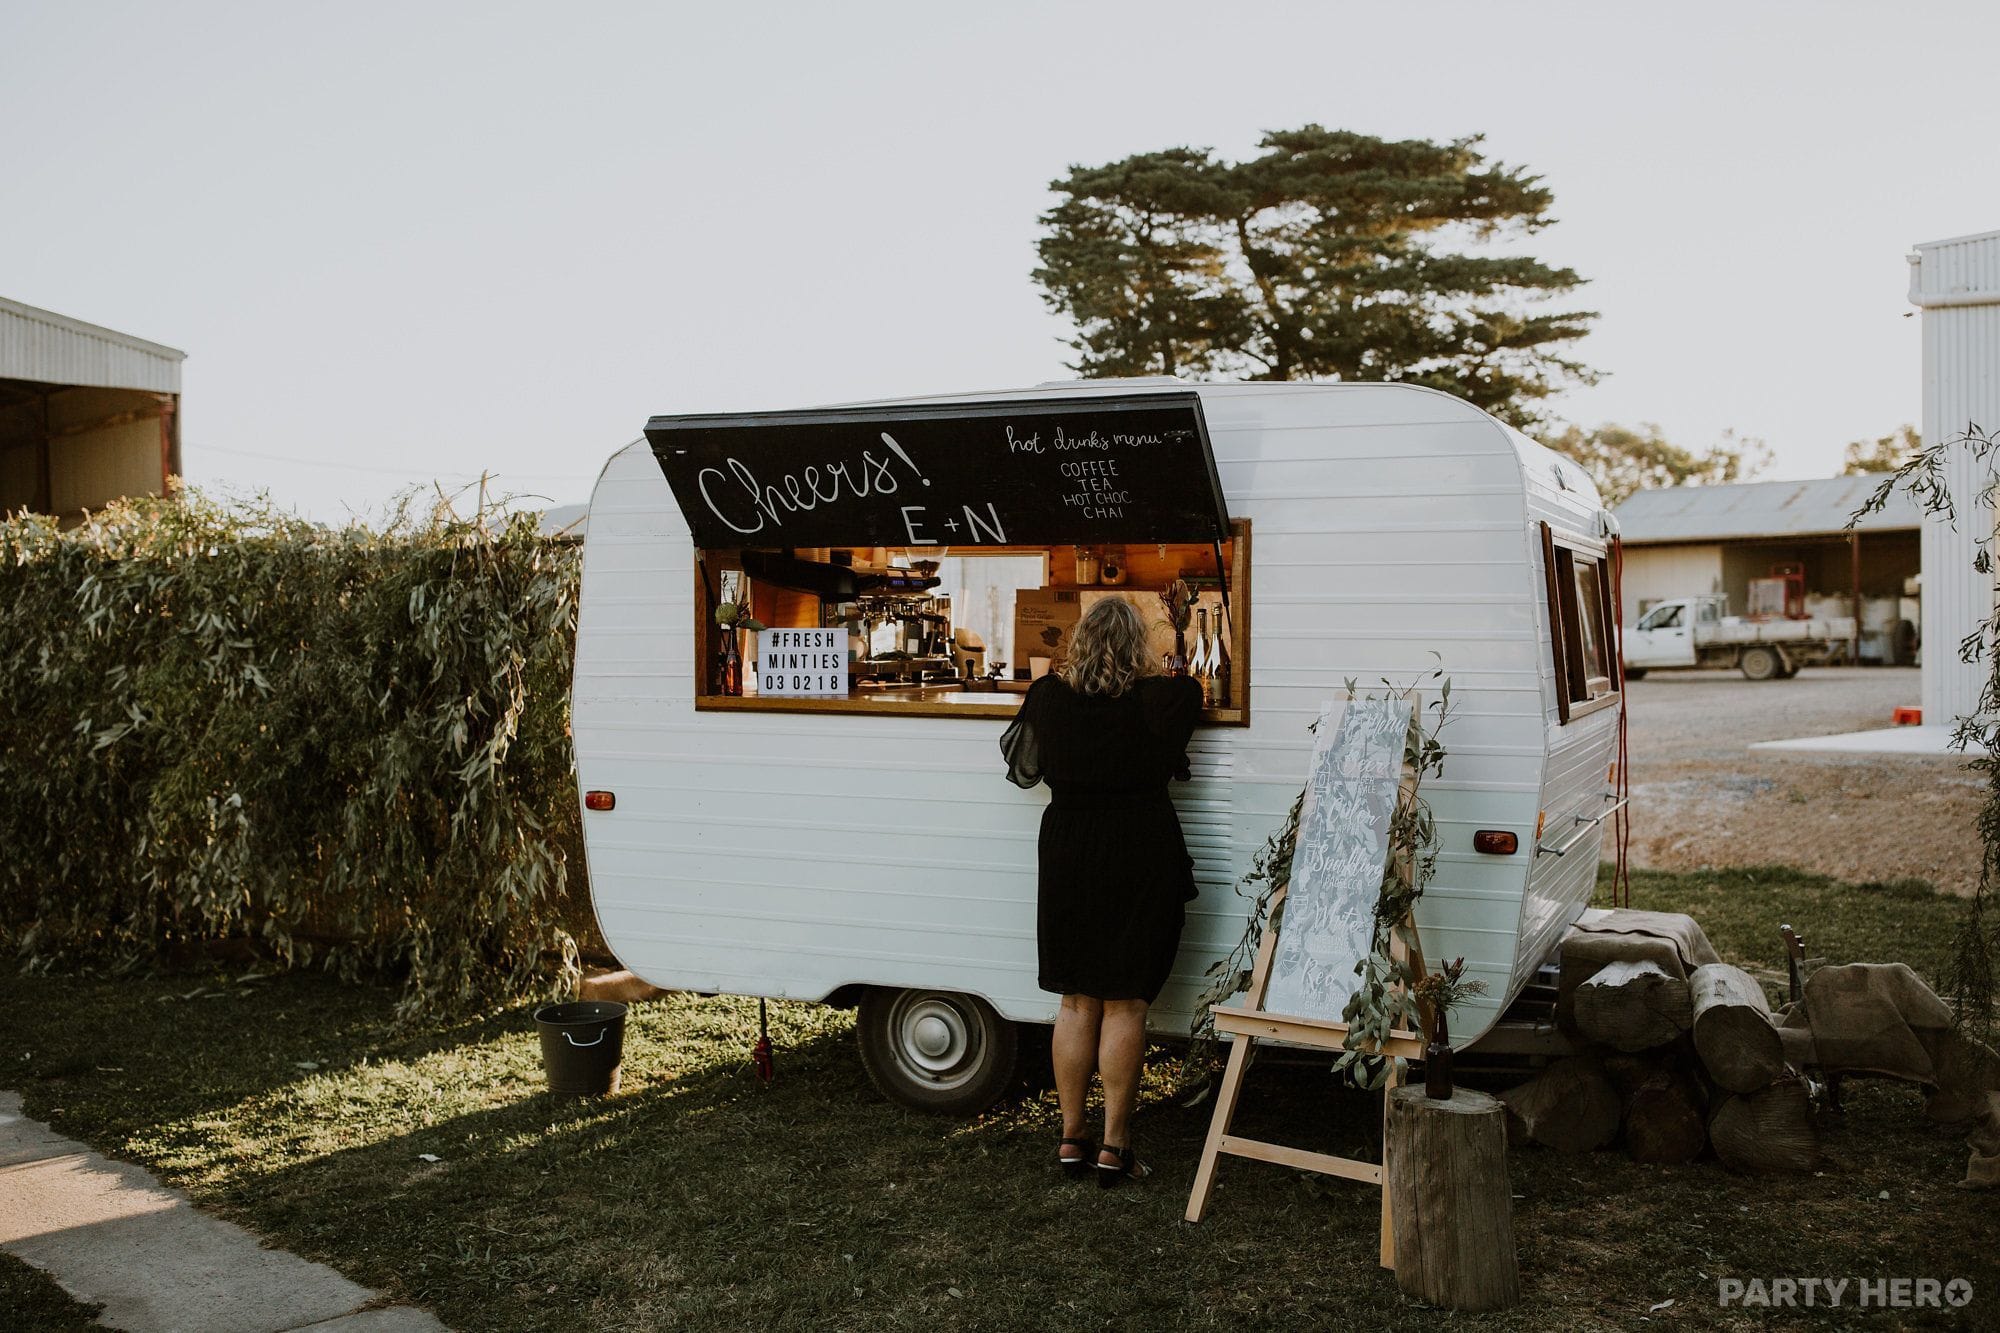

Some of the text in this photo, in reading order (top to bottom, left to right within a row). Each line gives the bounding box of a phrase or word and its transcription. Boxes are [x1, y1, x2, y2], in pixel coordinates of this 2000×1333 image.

[1006, 425, 1162, 454] hot drinks menu
[1060, 459, 1119, 477] COFFEE
[699, 432, 930, 533] Cheers!
[1077, 477, 1112, 492] TEA
[1062, 491, 1132, 506] HOT CHOC
[1083, 506, 1124, 519] CHAI
[772, 632, 834, 647] #FRESH
[768, 654, 839, 669] MINTIES
